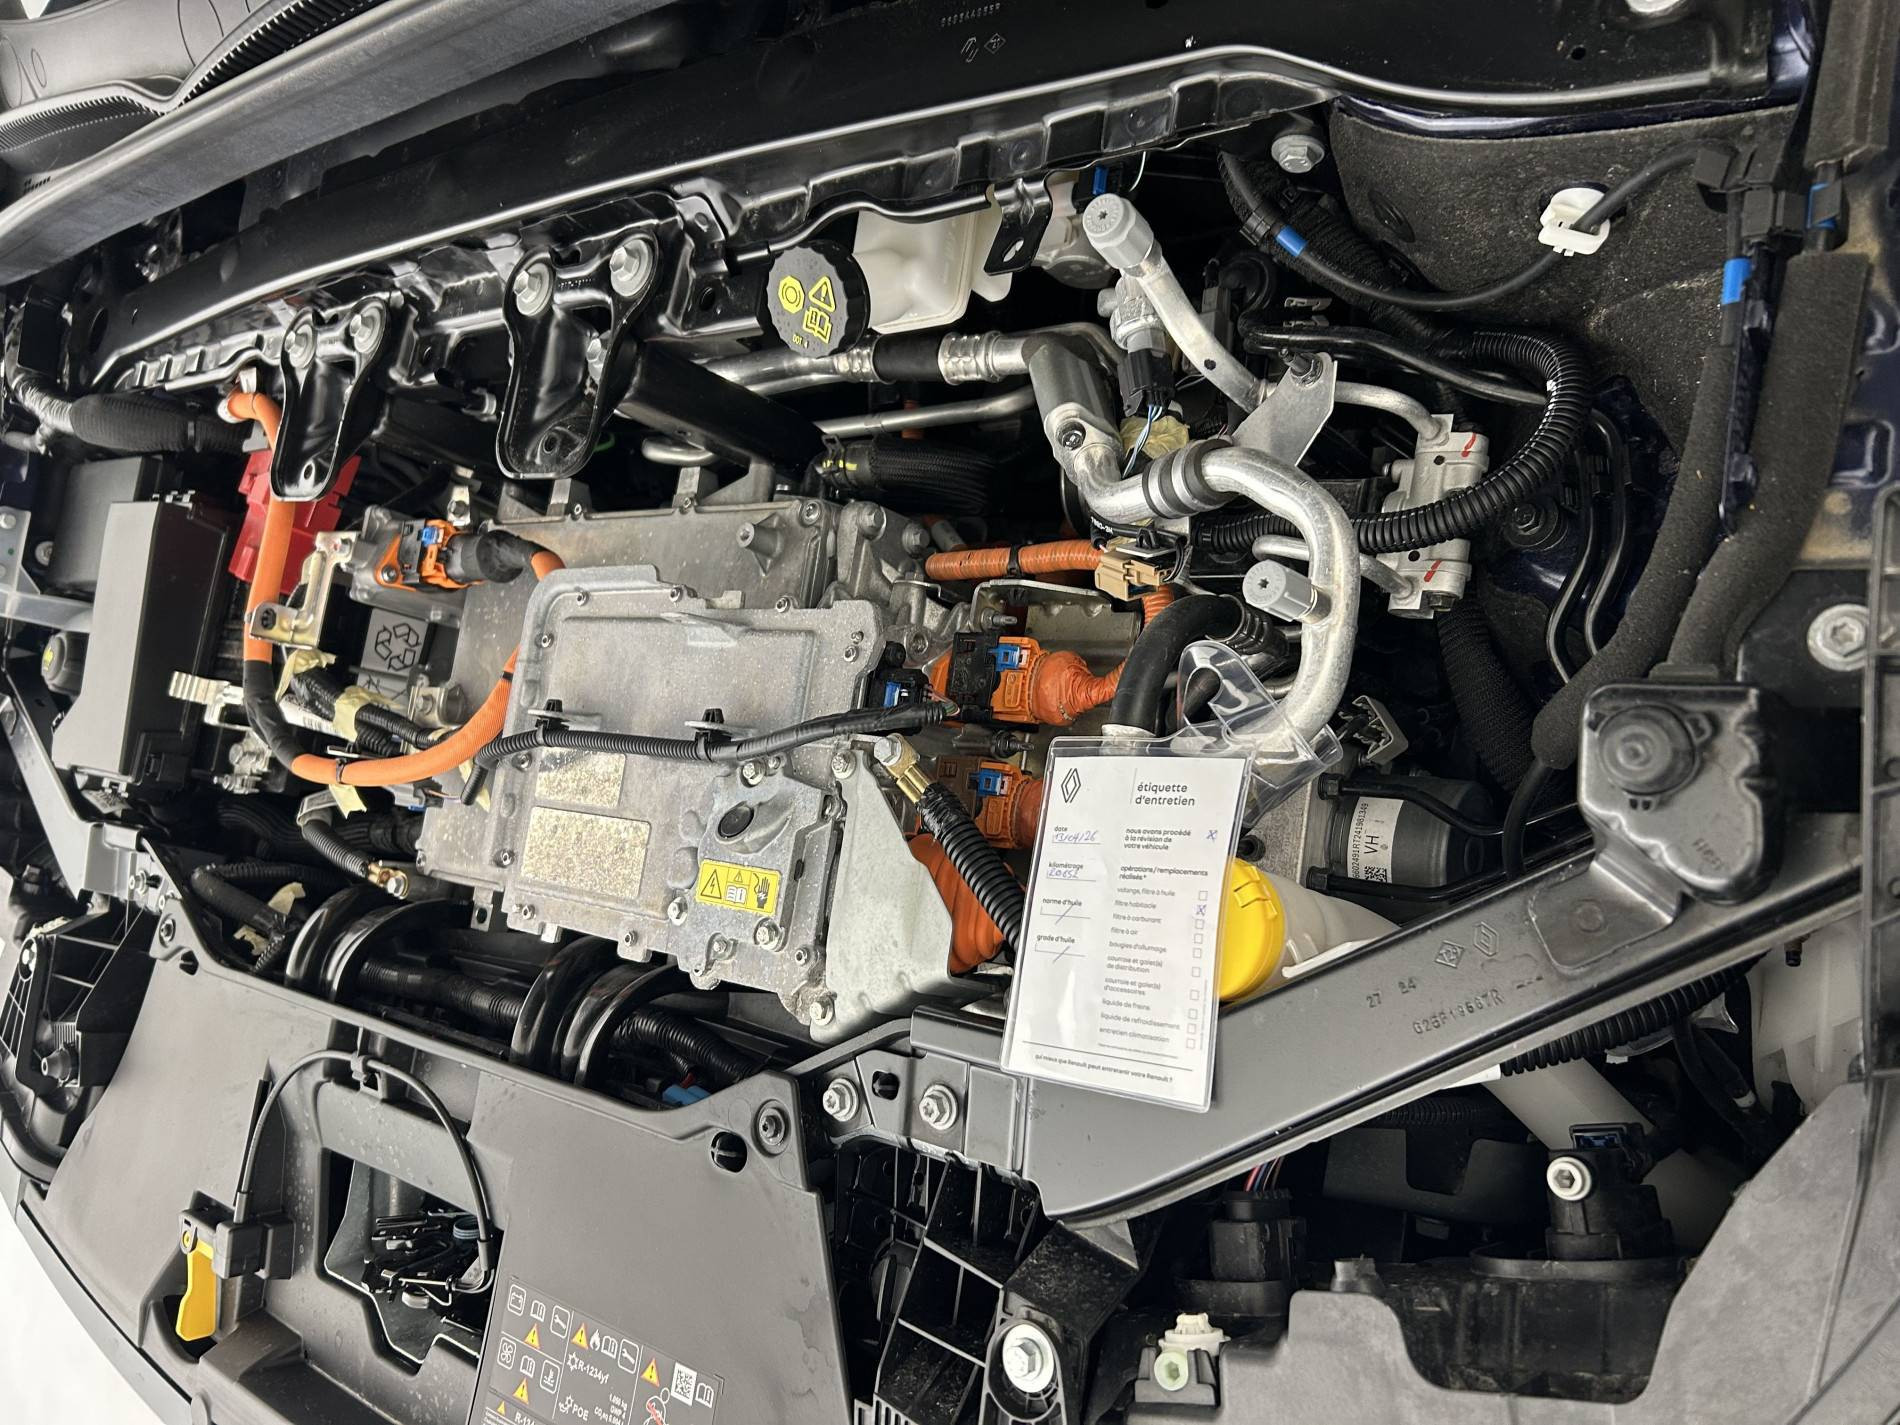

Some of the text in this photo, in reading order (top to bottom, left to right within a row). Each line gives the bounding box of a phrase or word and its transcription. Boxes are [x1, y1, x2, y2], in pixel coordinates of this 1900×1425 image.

[1137, 781, 1188, 794] étiquette
[1135, 795, 1195, 806] d'entretien
[1142, 828, 1162, 836] avons
[1162, 829, 1191, 837] procédé
[1137, 835, 1163, 843] révision
[1364, 834, 1380, 854] VH
[1141, 842, 1169, 850] véhicule
[1048, 861, 1084, 870] kilométrage
[1141, 887, 1155, 895] filtre
[1161, 889, 1176, 897] huile
[1042, 897, 1082, 907] norme d'huile
[1114, 899, 1157, 909] filtre habitacle
[1112, 912, 1127, 921] filtre
[1131, 915, 1163, 924] carburant
[1110, 926, 1125, 934] filtre
[1129, 928, 1139, 936] air
[1036, 934, 1075, 944] grade d'huile
[1108, 940, 1167, 954] bougies d'allumage
[1107, 955, 1132, 963] courroie
[1106, 962, 1150, 973] de distribution
[1102, 997, 1123, 1008] liquide
[1123, 1000, 1132, 1009] de
[1365, 992, 1383, 1009] 27
[1100, 1011, 1122, 1022] liquide
[1122, 1014, 1130, 1023] de
[577, 1359, 610, 1385] R-1234yf
[571, 1403, 589, 1421] POE
